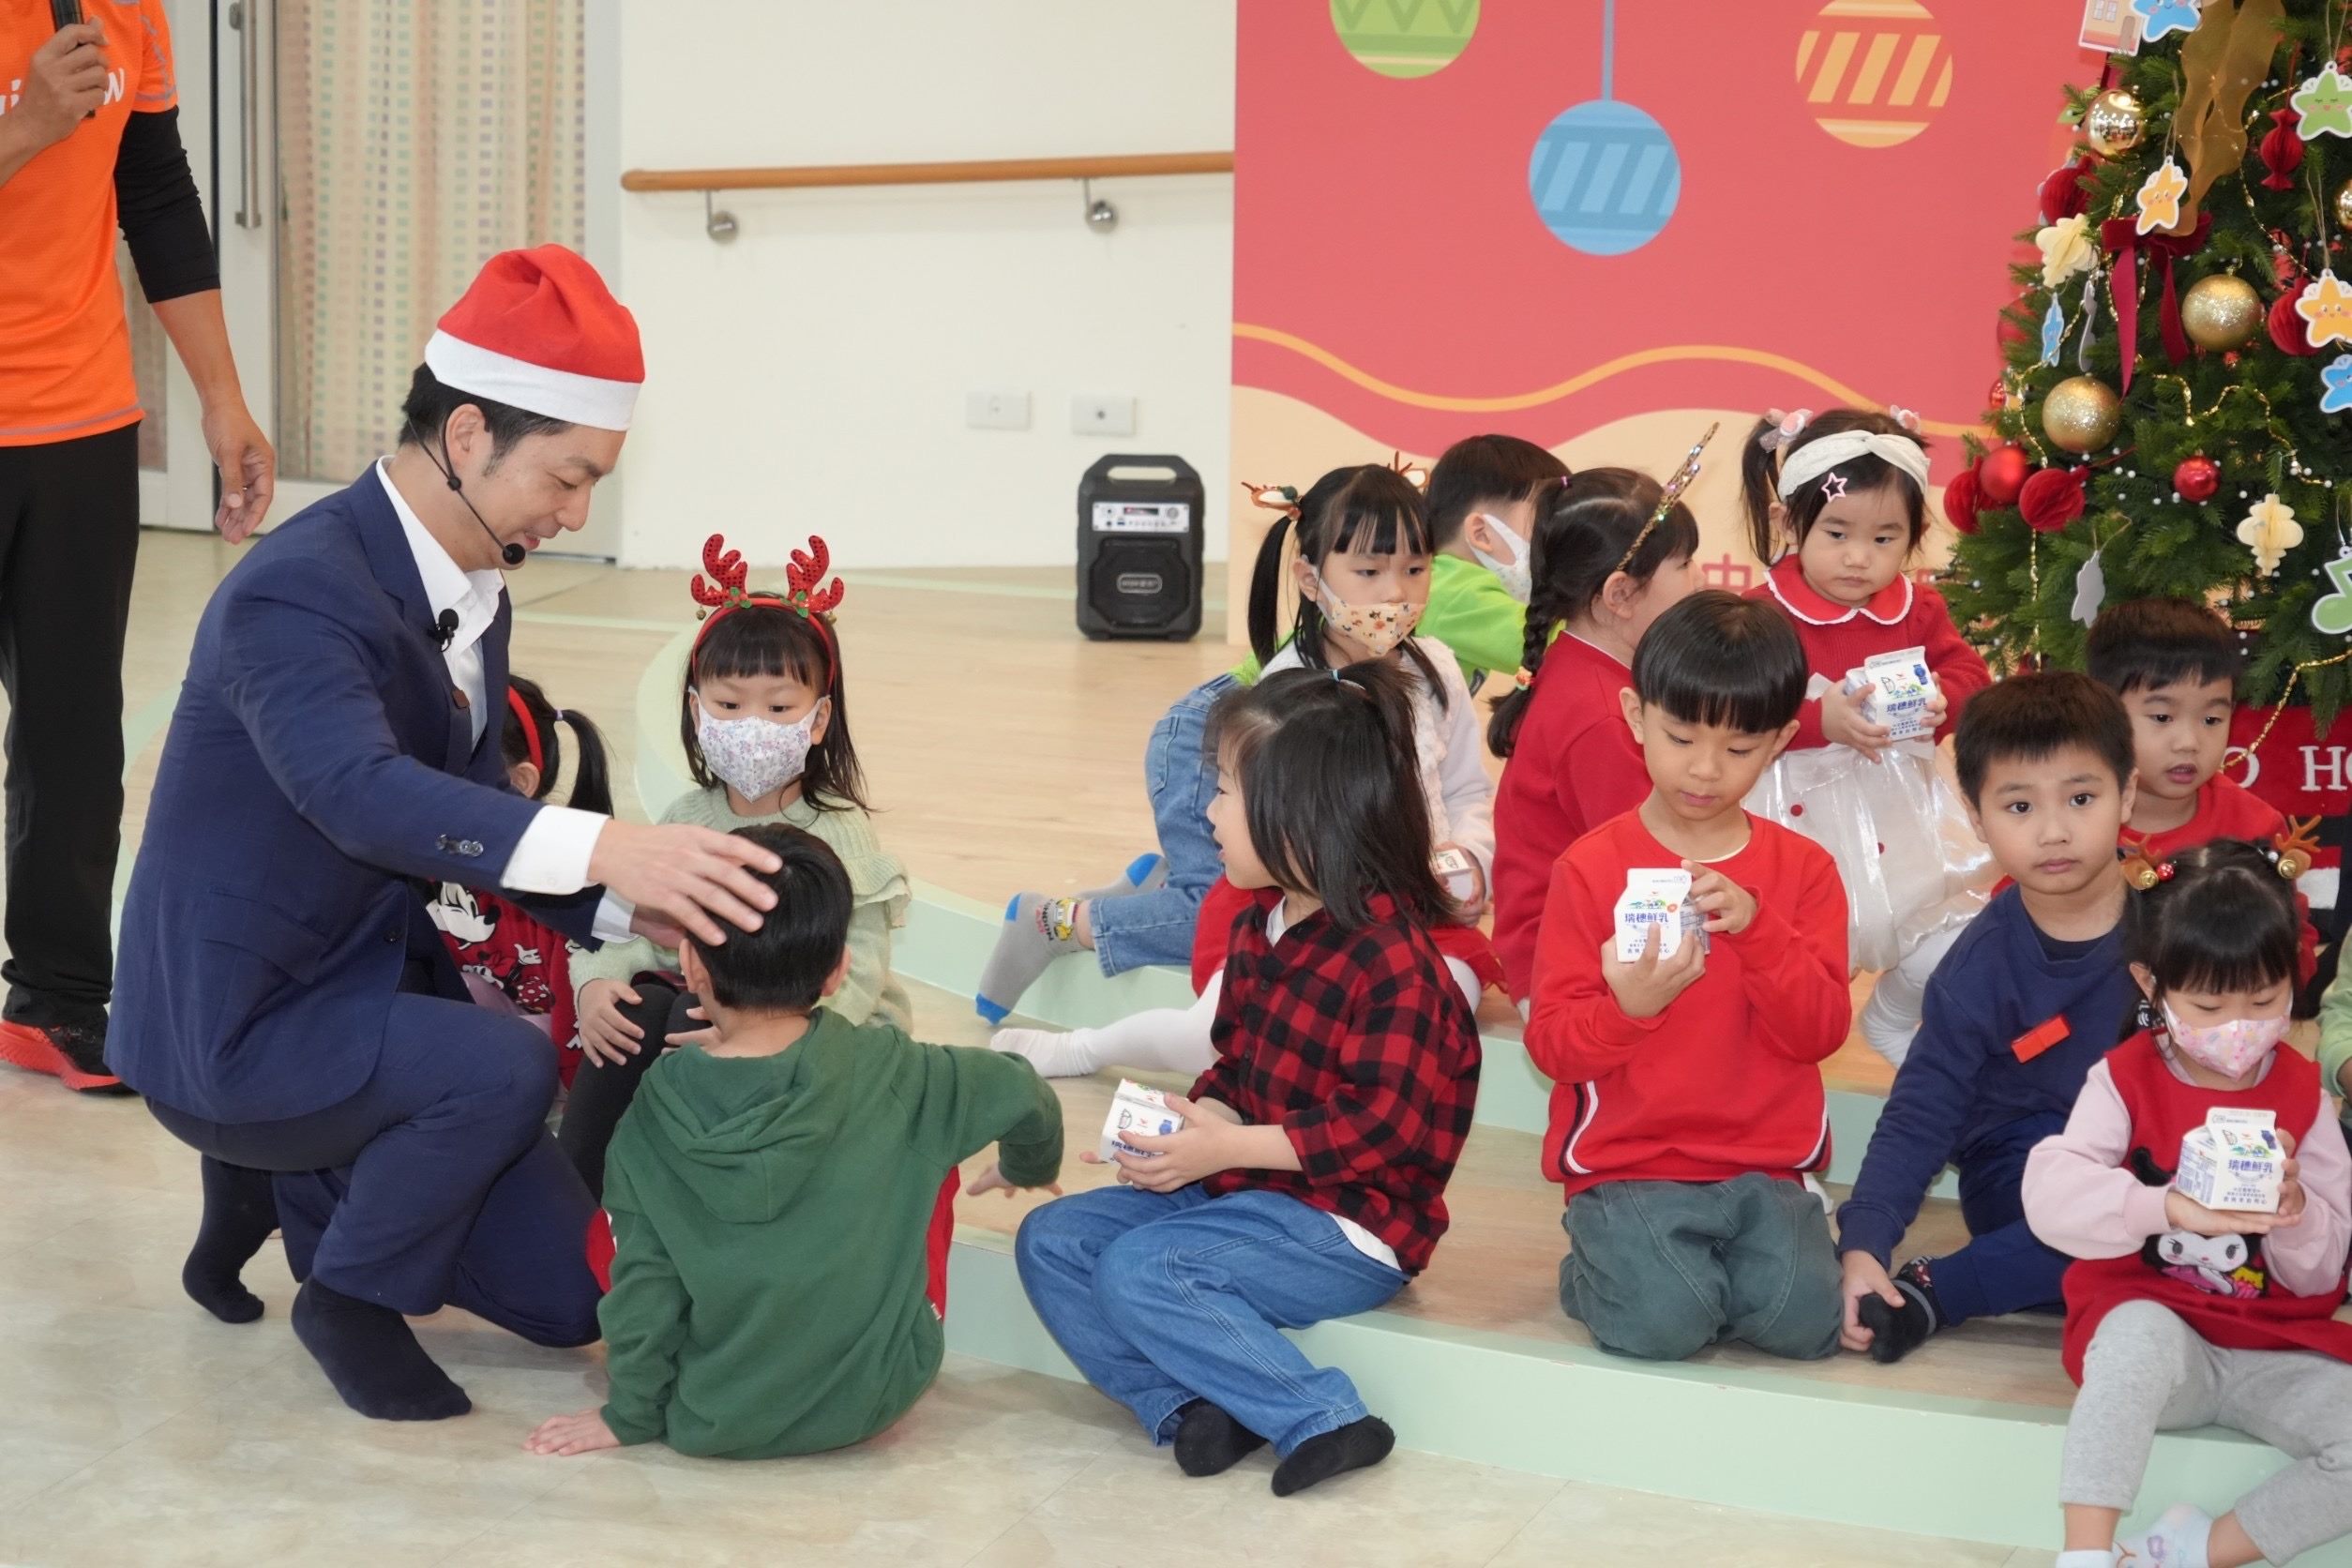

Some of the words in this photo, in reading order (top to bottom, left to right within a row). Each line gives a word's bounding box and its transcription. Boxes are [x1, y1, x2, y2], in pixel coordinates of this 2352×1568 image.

[2299, 746, 2352, 792] H
[1624, 912, 1669, 923] 瑞穗鮮乳
[2228, 1159, 2273, 1173] 瑞穗鮮乳
